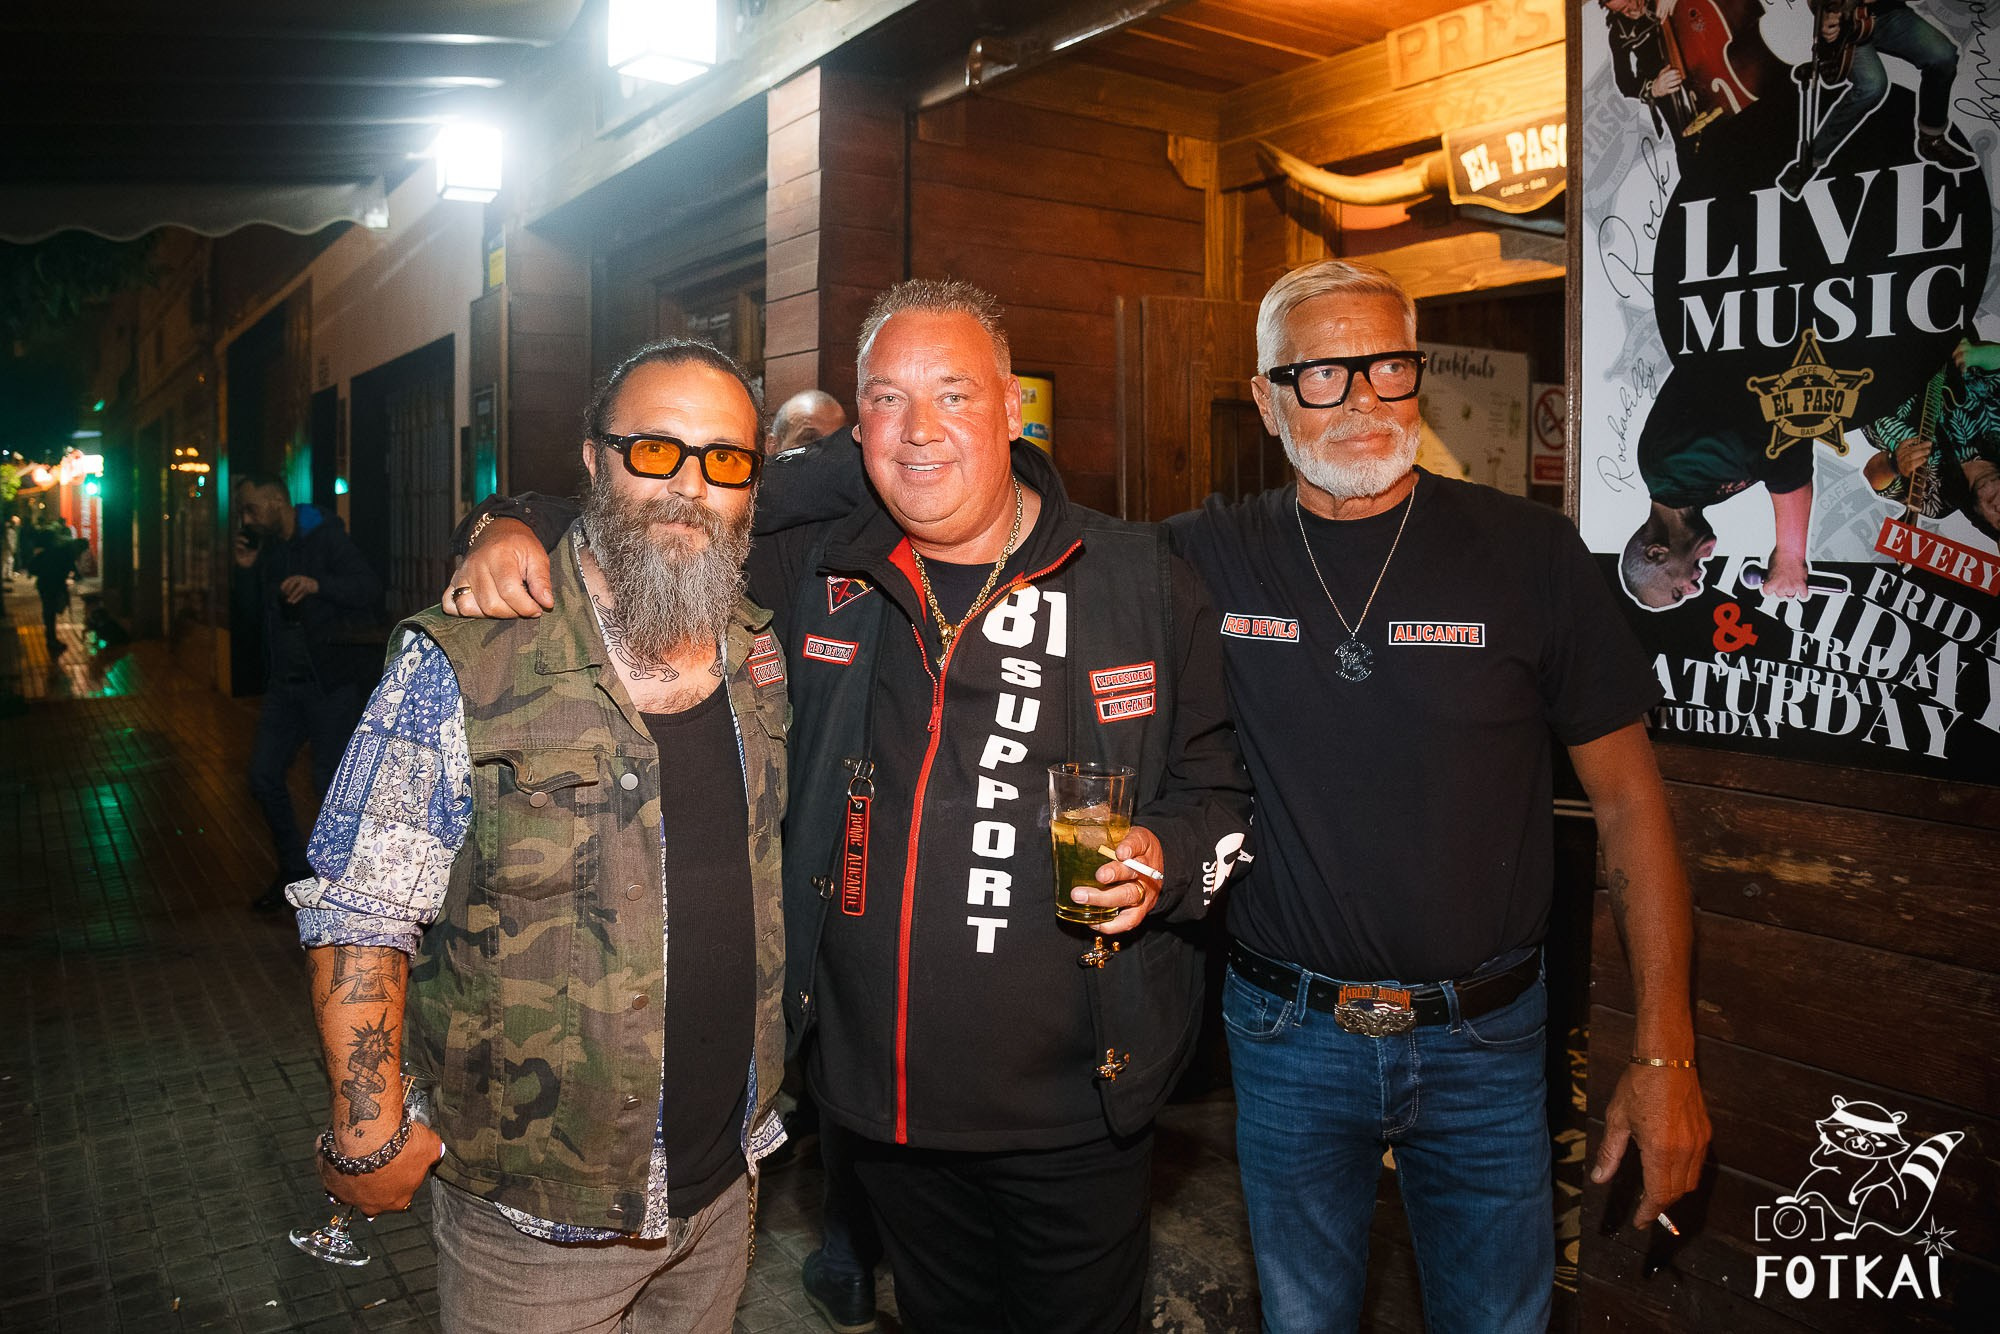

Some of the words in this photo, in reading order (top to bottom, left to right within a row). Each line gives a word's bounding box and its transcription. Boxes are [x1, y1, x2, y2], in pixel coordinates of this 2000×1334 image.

[1954, 0, 2000, 129] ountry
[1460, 143, 1501, 192] EL
[1598, 137, 1670, 299] Rock
[1679, 161, 1964, 285] LIVE
[1679, 264, 1966, 355] MUSIC
[1597, 357, 1656, 493] Rockabilly
[1772, 391, 1793, 416] EL
[1802, 388, 1845, 414] PASO
[1800, 428, 1816, 437] BAR
[1883, 523, 2000, 592] EVERY
[982, 583, 1067, 658] 81
[1225, 616, 1251, 636] RED
[1252, 618, 1298, 640] DEVILS
[1393, 624, 1480, 644] ALICANTE
[1712, 603, 1758, 652] &
[1862, 567, 2000, 660] FRIDA
[1642, 706, 1780, 739] TURDAY
[1651, 653, 1965, 760] ATURDAY
[966, 657, 1042, 954] SUPPORT
